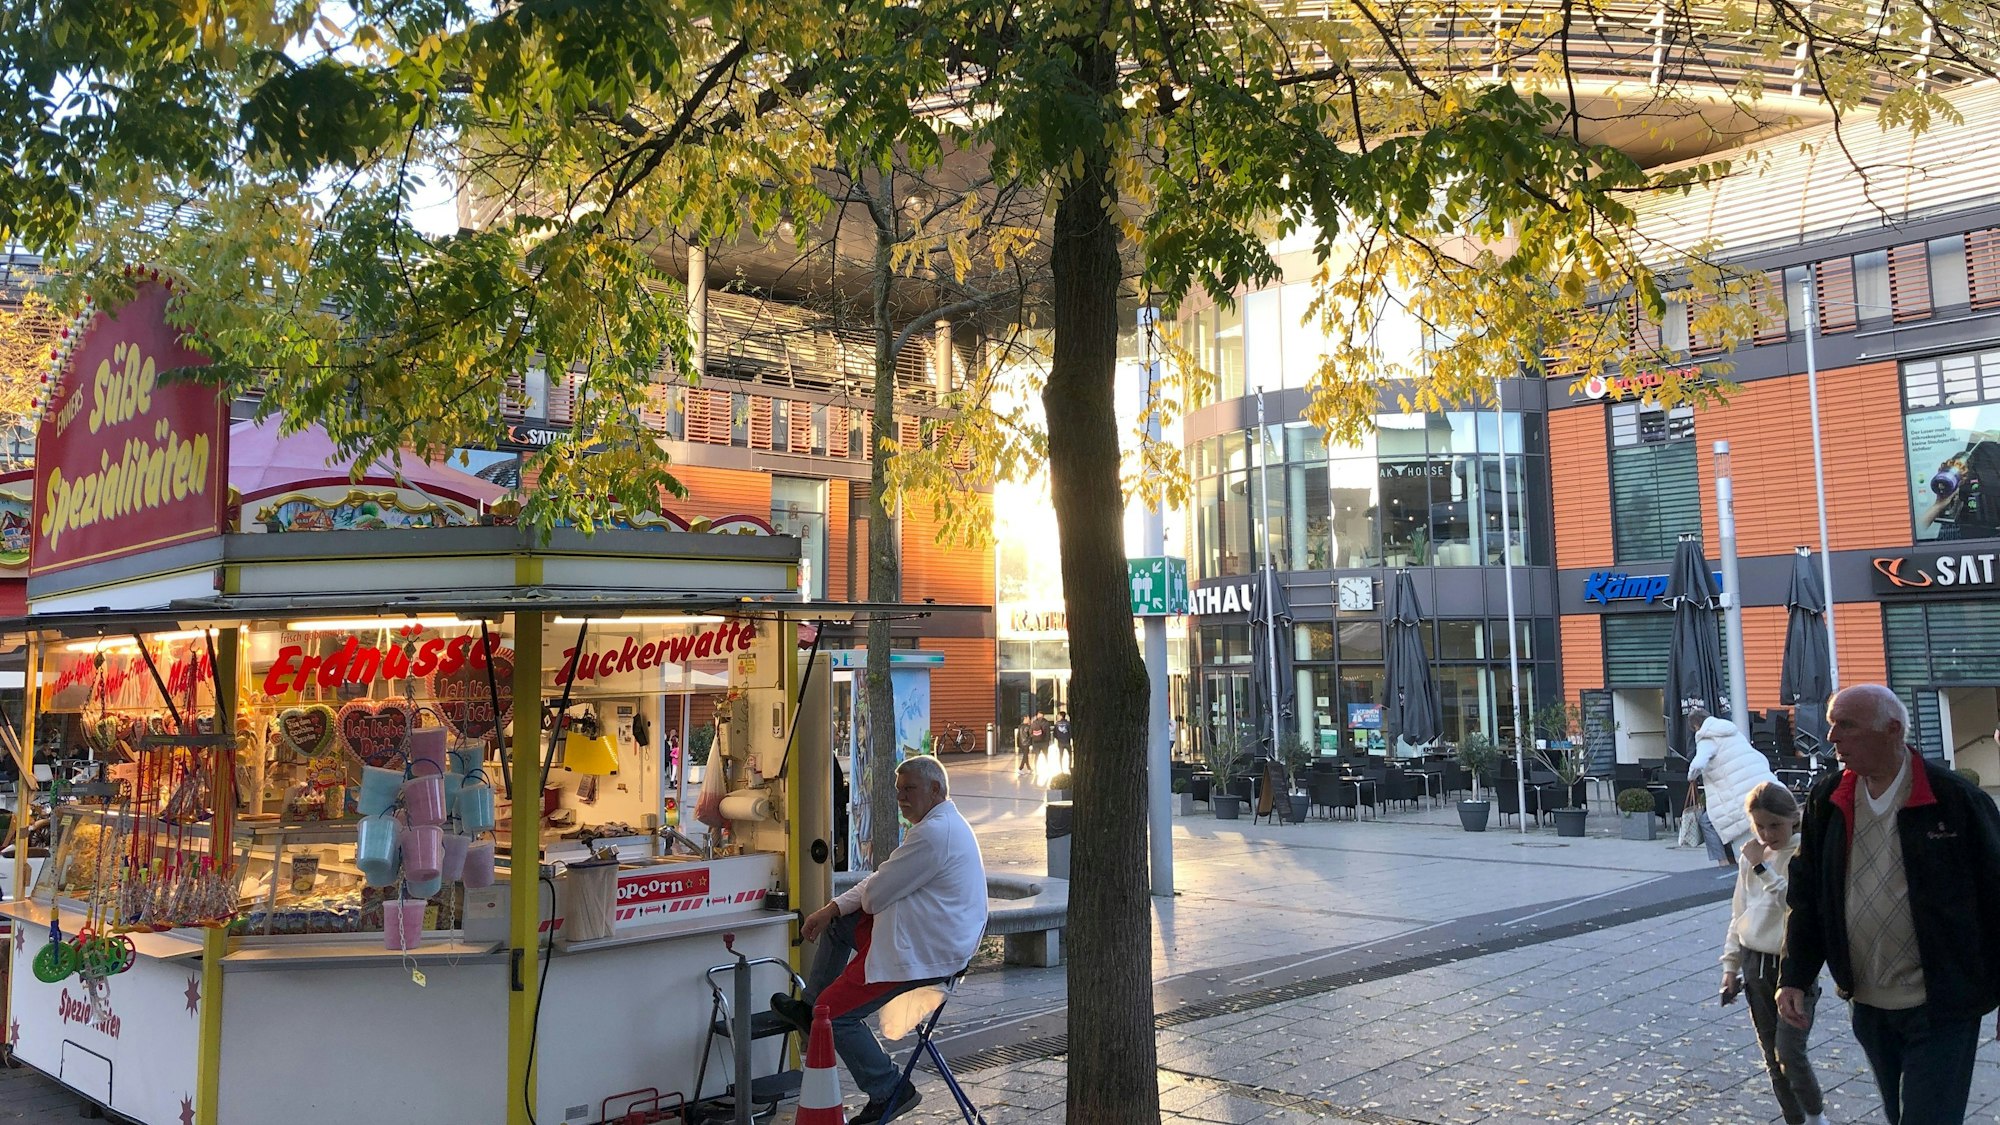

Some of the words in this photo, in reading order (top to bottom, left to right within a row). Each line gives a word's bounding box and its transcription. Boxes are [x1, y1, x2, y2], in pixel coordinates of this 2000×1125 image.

[89, 341, 156, 435] Süße
[41, 417, 210, 553] Spezialitäten
[1407, 466, 1443, 477] HOUSE
[1936, 554, 2000, 586] SAT
[1188, 583, 1257, 616] ATHAU
[281, 632, 302, 644] frisch
[554, 621, 756, 686] Zuckerwatte
[263, 622, 501, 696] Erdnüsse
[346, 719, 369, 738] Ich
[371, 719, 404, 738] liebe
[617, 879, 683, 900] opcorn
